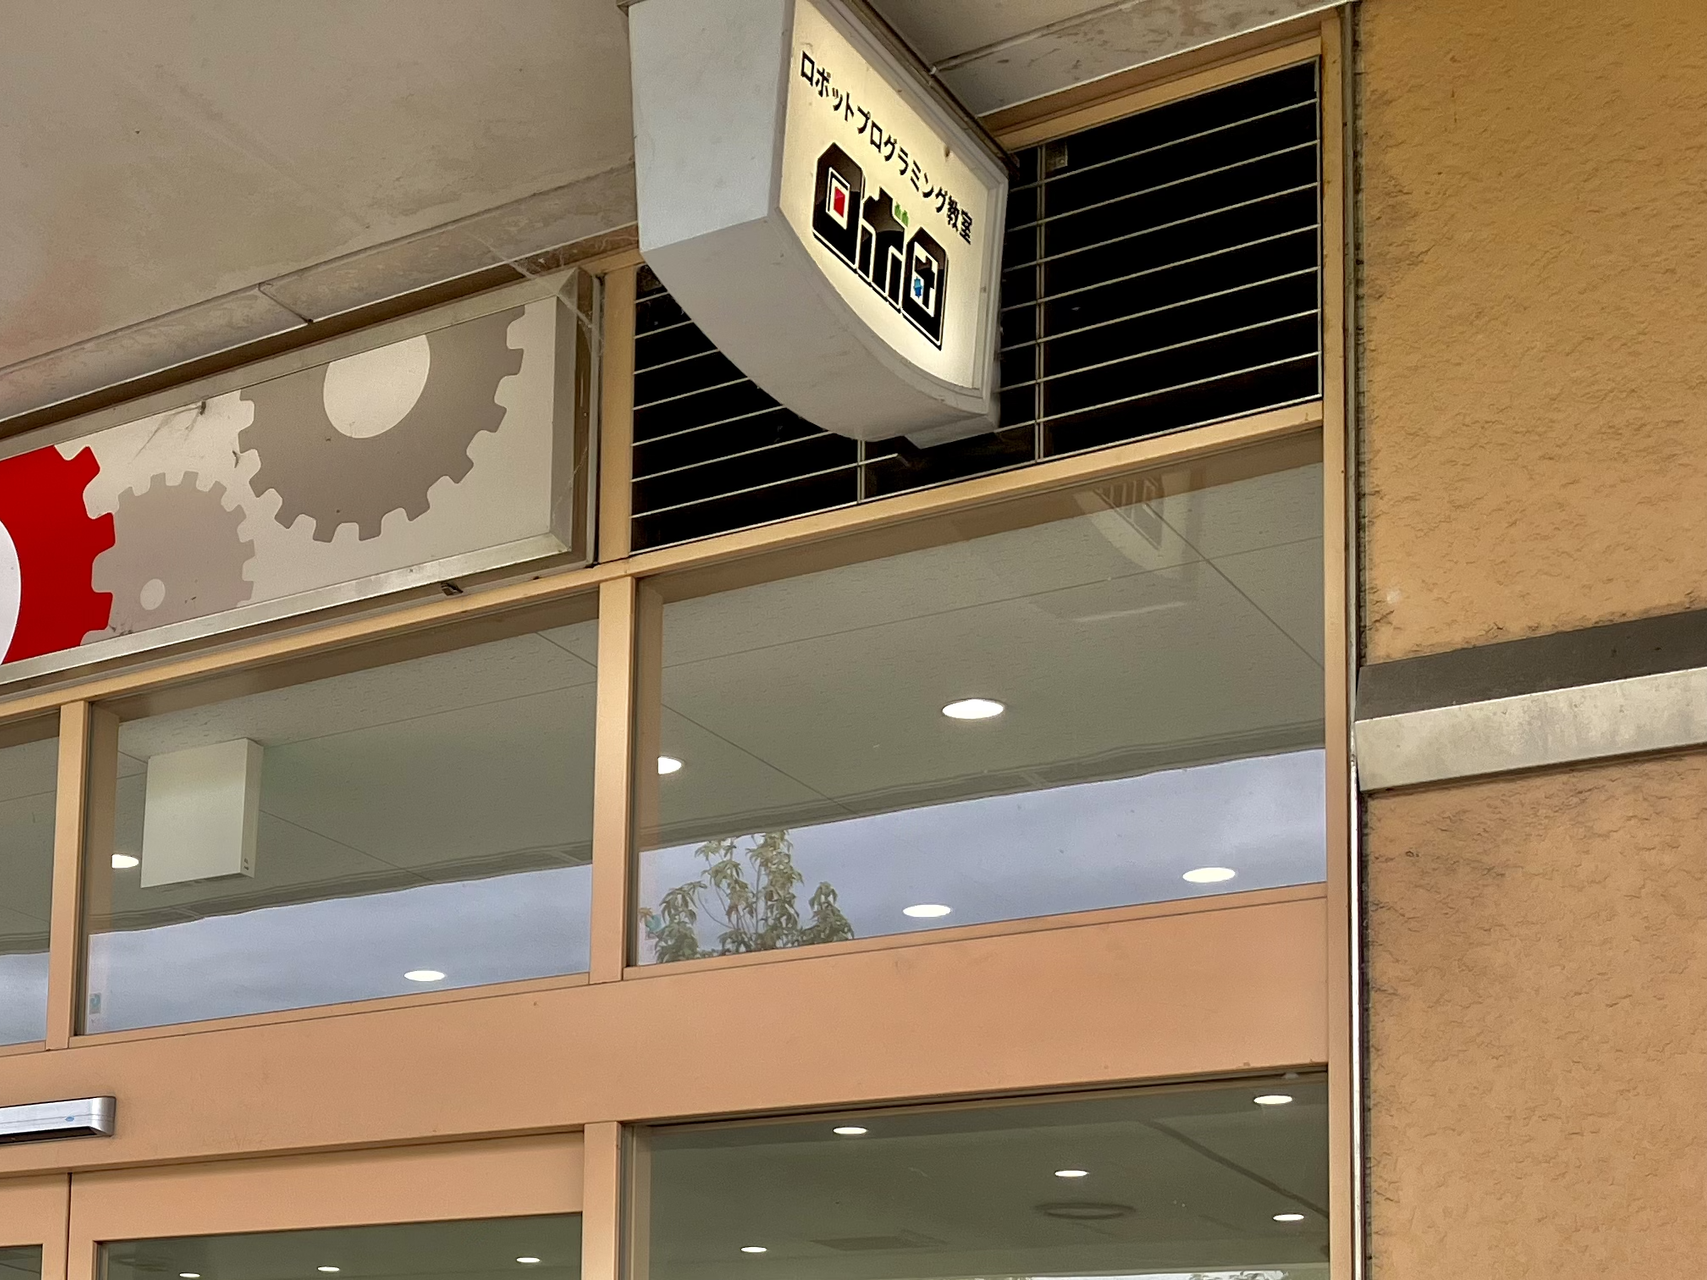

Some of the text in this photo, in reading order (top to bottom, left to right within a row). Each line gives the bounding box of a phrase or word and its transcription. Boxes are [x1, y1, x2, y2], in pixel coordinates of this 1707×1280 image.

[801, 50, 974, 245] ロボットプログラミング教室
